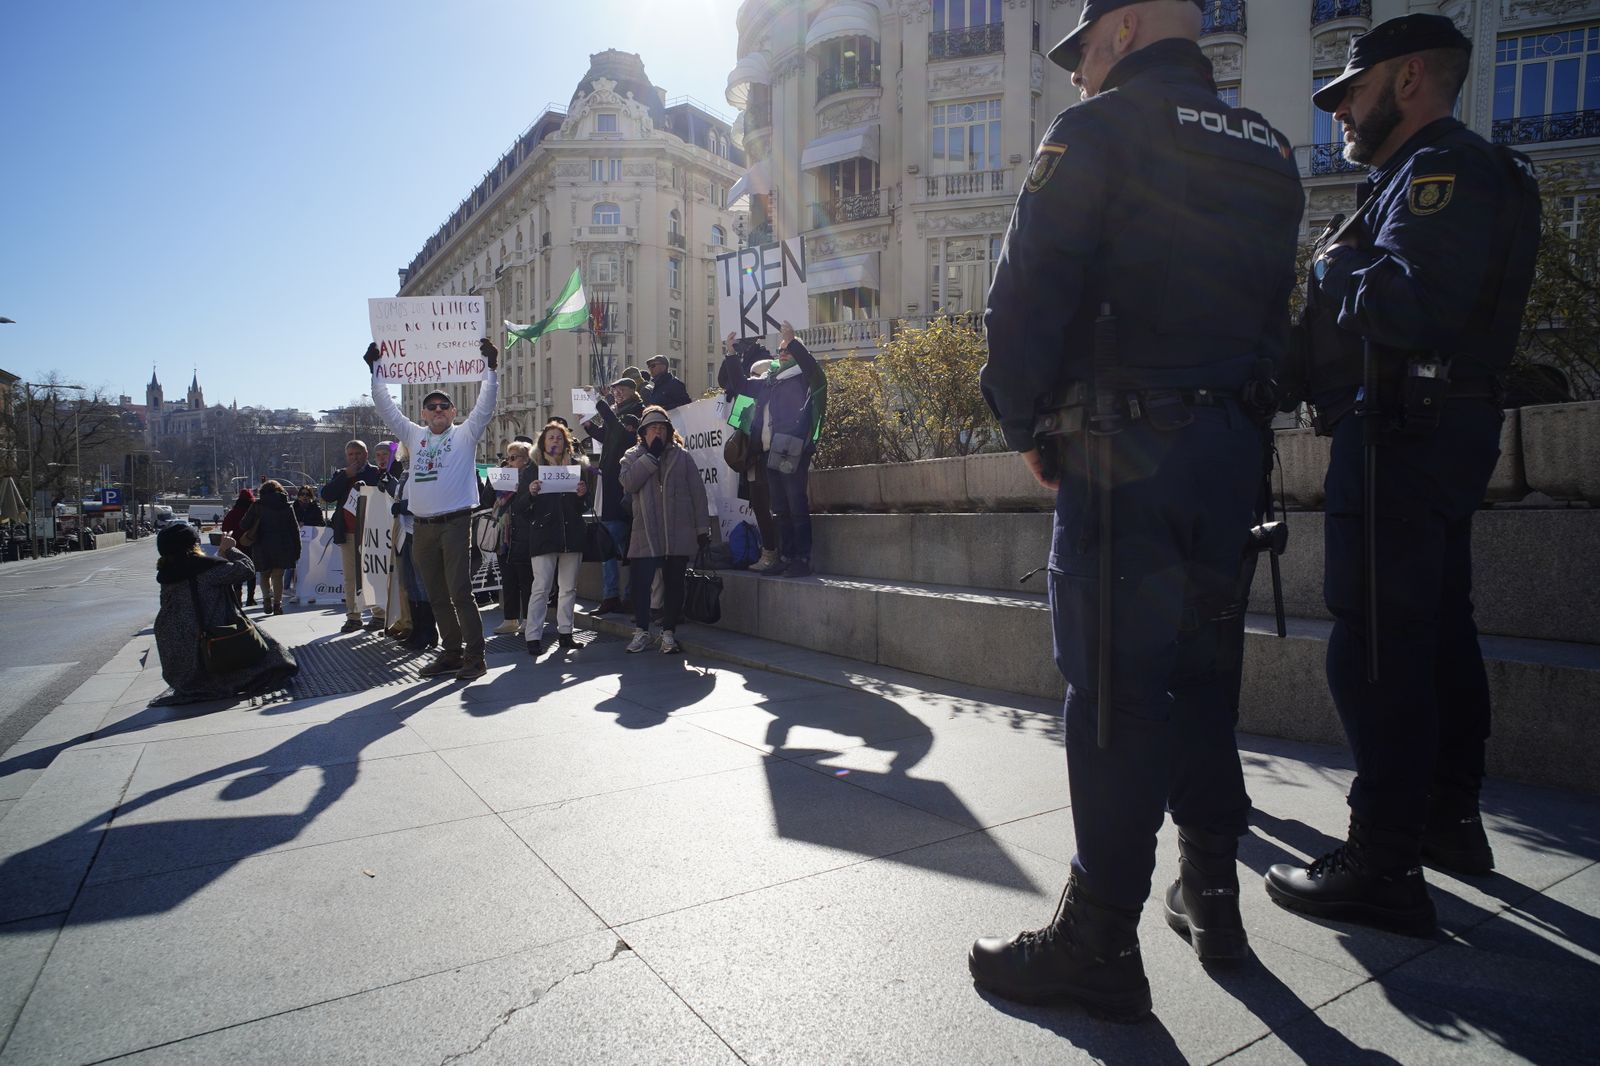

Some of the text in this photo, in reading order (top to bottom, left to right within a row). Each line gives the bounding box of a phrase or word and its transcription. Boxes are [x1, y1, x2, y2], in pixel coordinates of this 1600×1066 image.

[716, 235, 807, 297] TREN
[740, 289, 782, 339] KK
[380, 339, 406, 358] AVE
[376, 358, 486, 379] ALGECIRAS-MADRID
[105, 490, 117, 504] P
[363, 554, 388, 575] SIN
[315, 583, 345, 594] @nd
